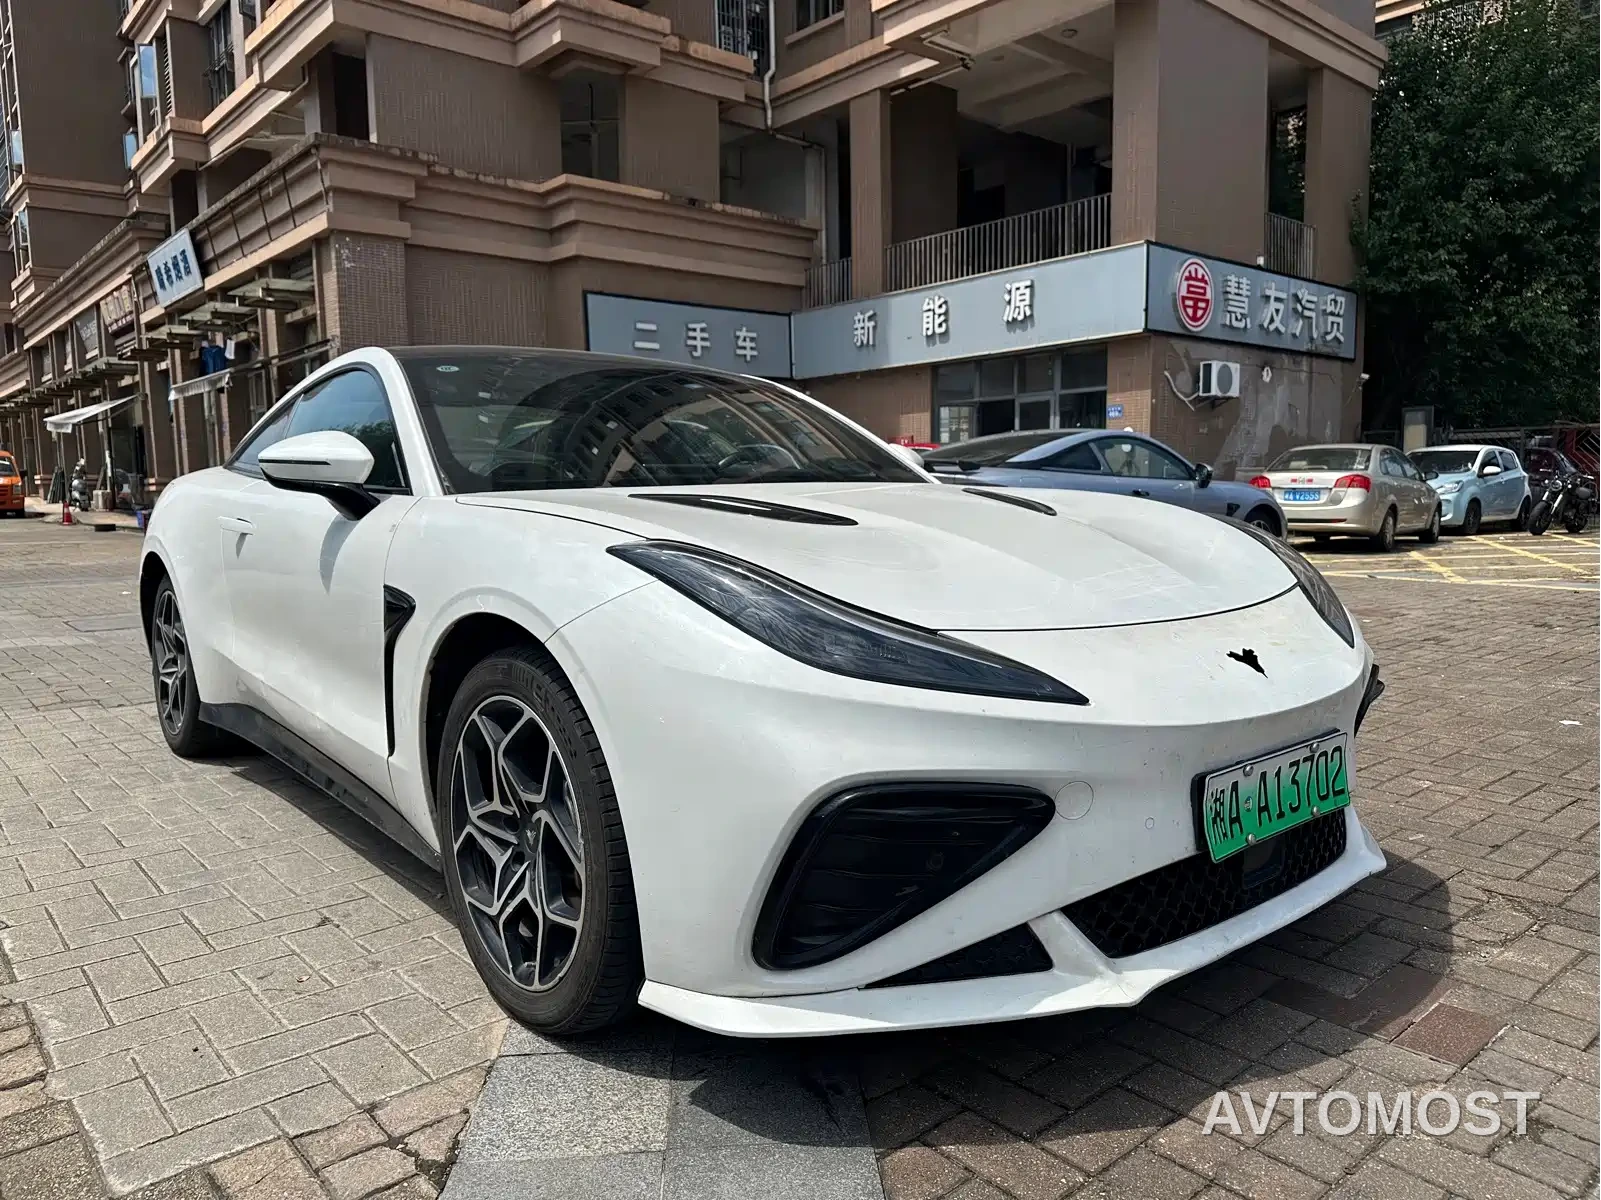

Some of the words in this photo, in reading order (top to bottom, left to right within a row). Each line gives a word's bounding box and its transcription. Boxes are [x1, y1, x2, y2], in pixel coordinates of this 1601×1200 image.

[633, 321, 759, 362] 二手车
[852, 279, 1032, 347] 新能源
[1224, 273, 1346, 343] 慧友汽贸
